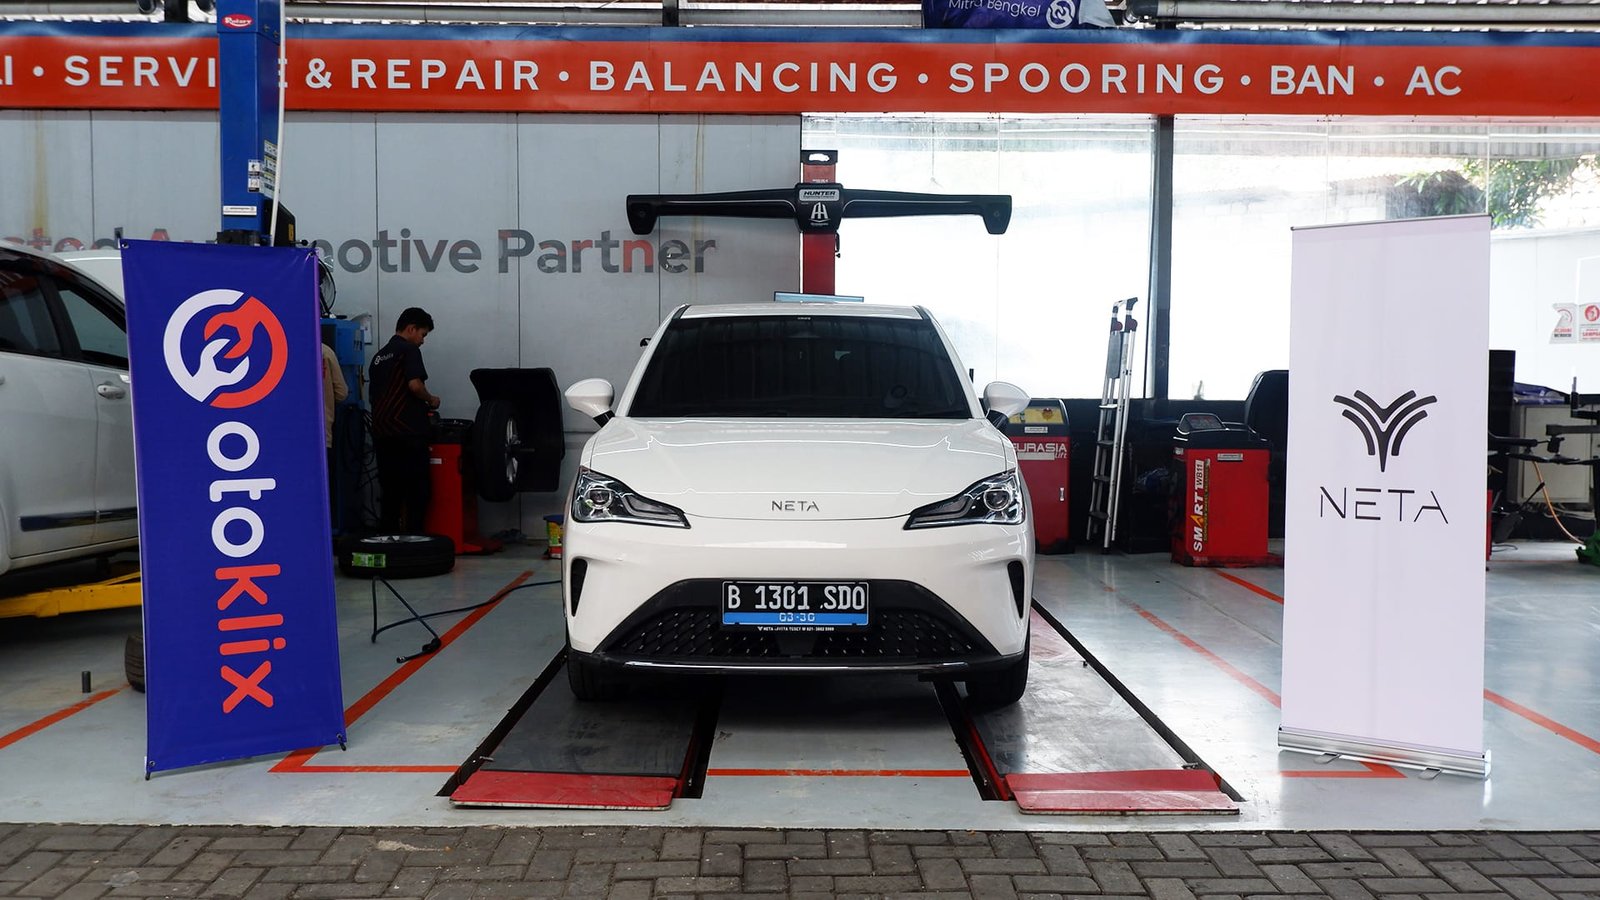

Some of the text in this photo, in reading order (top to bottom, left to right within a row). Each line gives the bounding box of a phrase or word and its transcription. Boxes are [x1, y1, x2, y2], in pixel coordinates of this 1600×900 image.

[949, 0, 1041, 17] Mitra Bengkel
[305, 57, 332, 89] &
[351, 58, 539, 91] REPAIR
[589, 60, 898, 93] BALANCING
[948, 62, 1224, 95] SPOORING
[1270, 65, 1355, 96] BAN
[1405, 65, 1463, 96] AC
[497, 229, 716, 274] Partner
[771, 500, 819, 512] NETA
[1191, 491, 1204, 552] SMART
[1319, 486, 1449, 524] NETA
[206, 420, 287, 714] otoklix
[727, 584, 865, 610] B 1301 SDO
